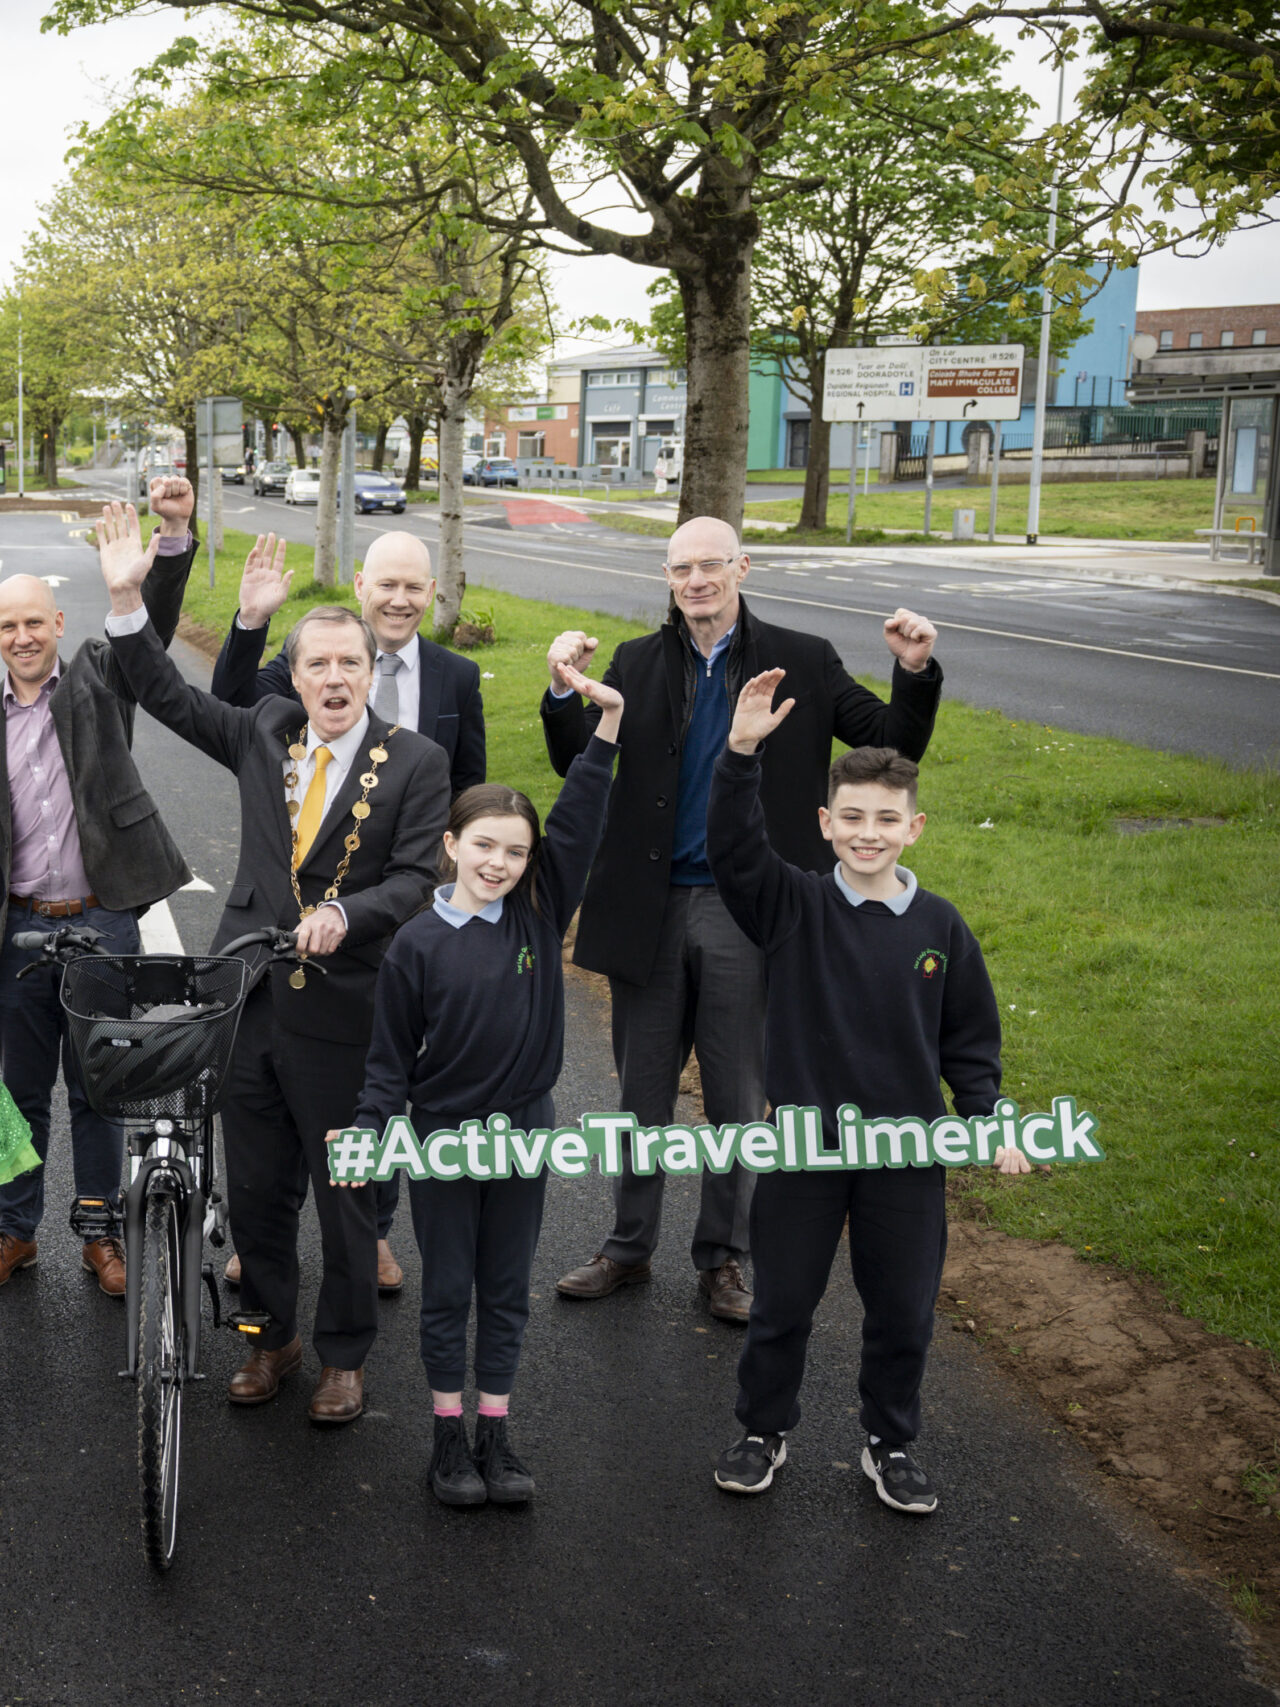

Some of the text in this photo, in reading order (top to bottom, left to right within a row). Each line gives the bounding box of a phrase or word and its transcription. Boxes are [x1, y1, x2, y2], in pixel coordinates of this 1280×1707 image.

[951, 356, 985, 364] CENTRE
[857, 370, 914, 378] DOORADOYLE
[955, 378, 1012, 386] IMMACULATE
[977, 386, 1016, 394] COLLEGE
[332, 1099, 1100, 1178] #ActiveTravelLimerick
